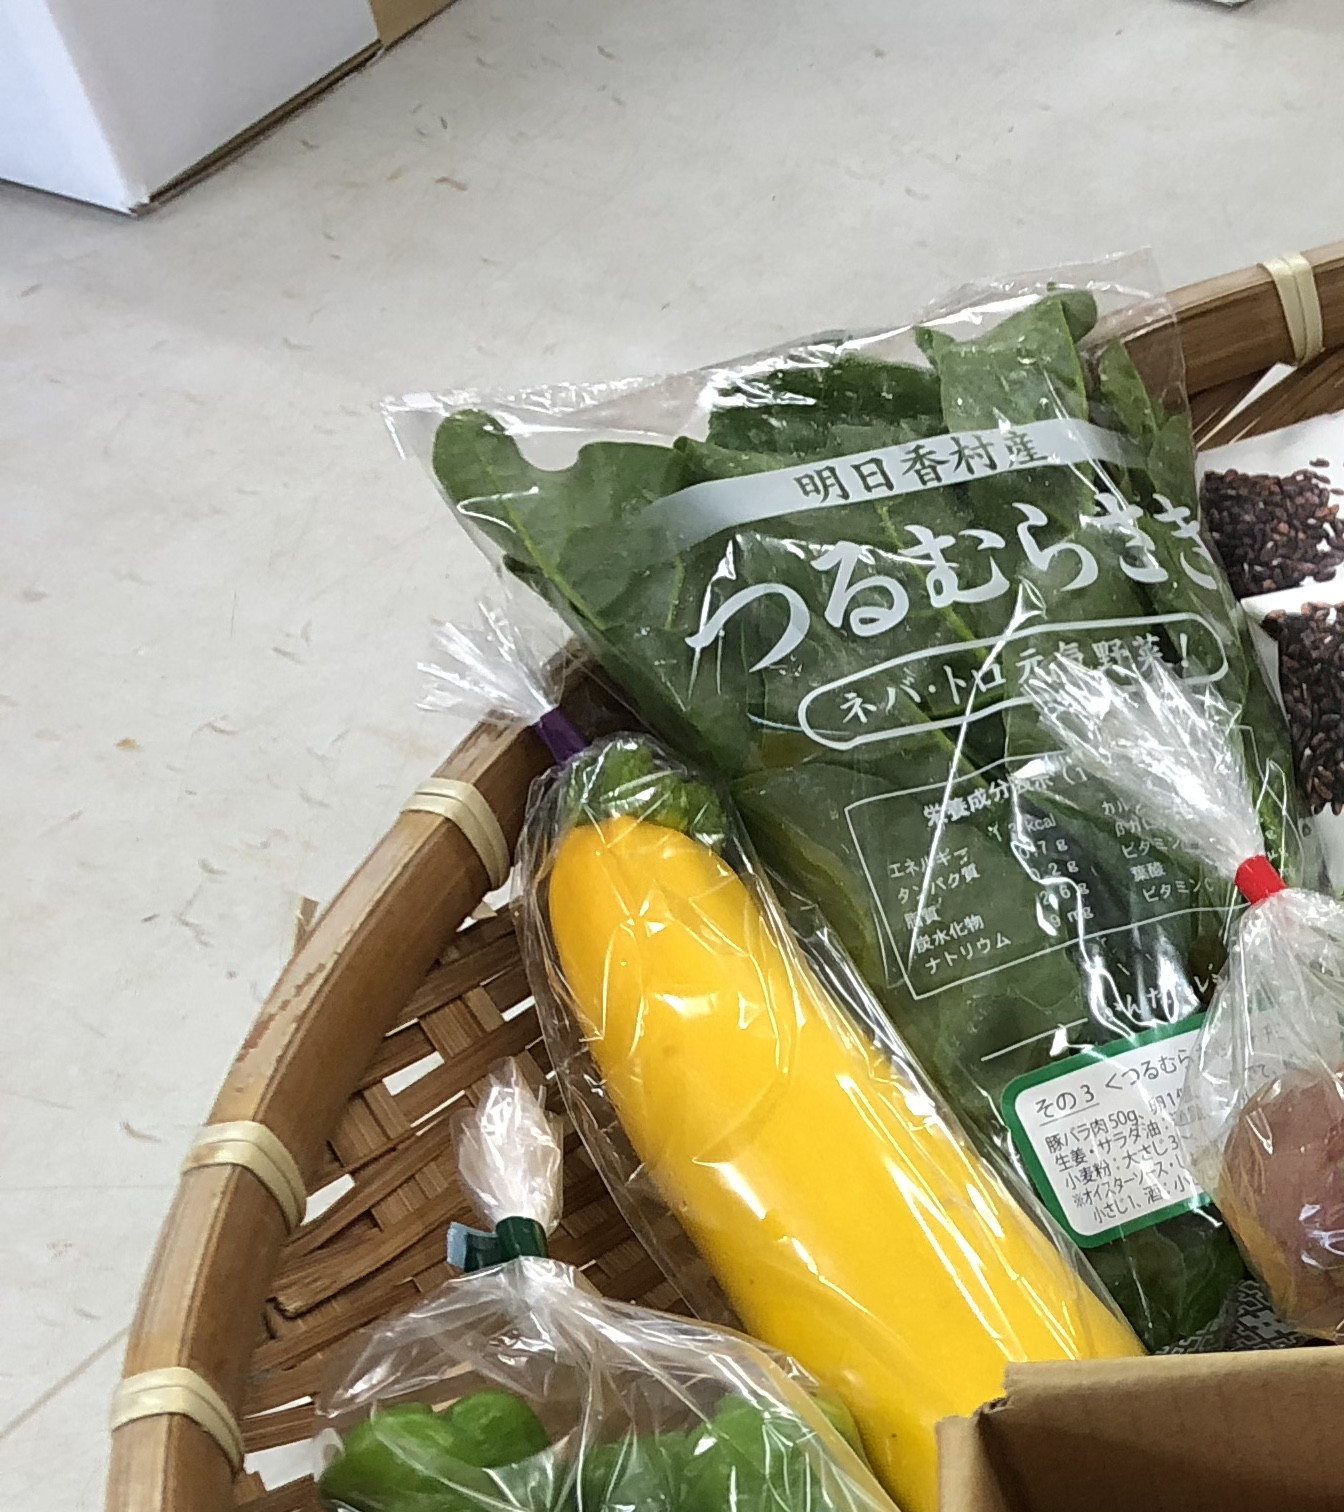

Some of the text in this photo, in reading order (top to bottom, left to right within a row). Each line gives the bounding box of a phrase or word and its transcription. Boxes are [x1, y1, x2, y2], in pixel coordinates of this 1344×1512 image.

[795, 429, 1050, 506] 明日香村産
[685, 490, 1220, 673] つるむらさき
[1122, 837, 1186, 860] ビタミン
[916, 917, 986, 954] 炭水化物
[1131, 861, 1167, 882] 葉酸
[925, 934, 1012, 976] ナトリウム
[1035, 1083, 1095, 1119] その3
